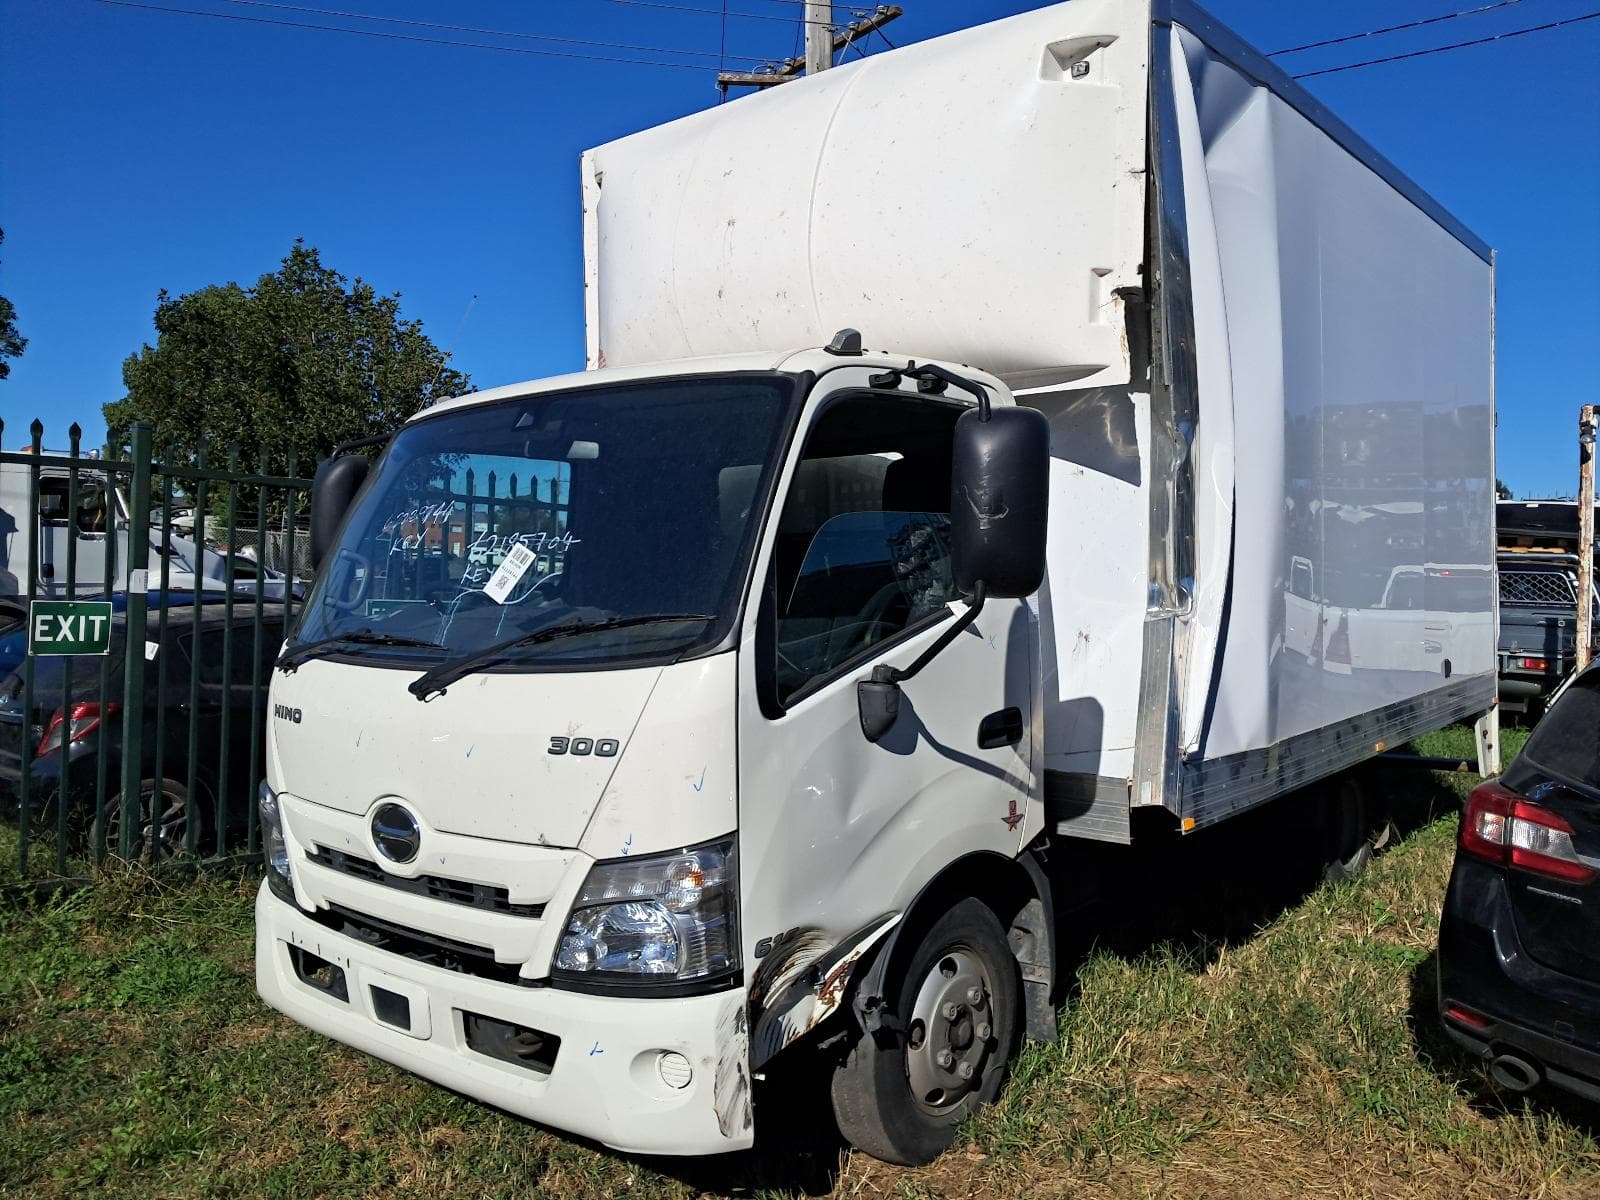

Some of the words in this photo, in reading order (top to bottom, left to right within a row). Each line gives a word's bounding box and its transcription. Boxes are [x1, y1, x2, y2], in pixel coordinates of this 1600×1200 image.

[34, 614, 107, 642] EXIT
[274, 703, 302, 724] HINO
[547, 736, 620, 757] 300
